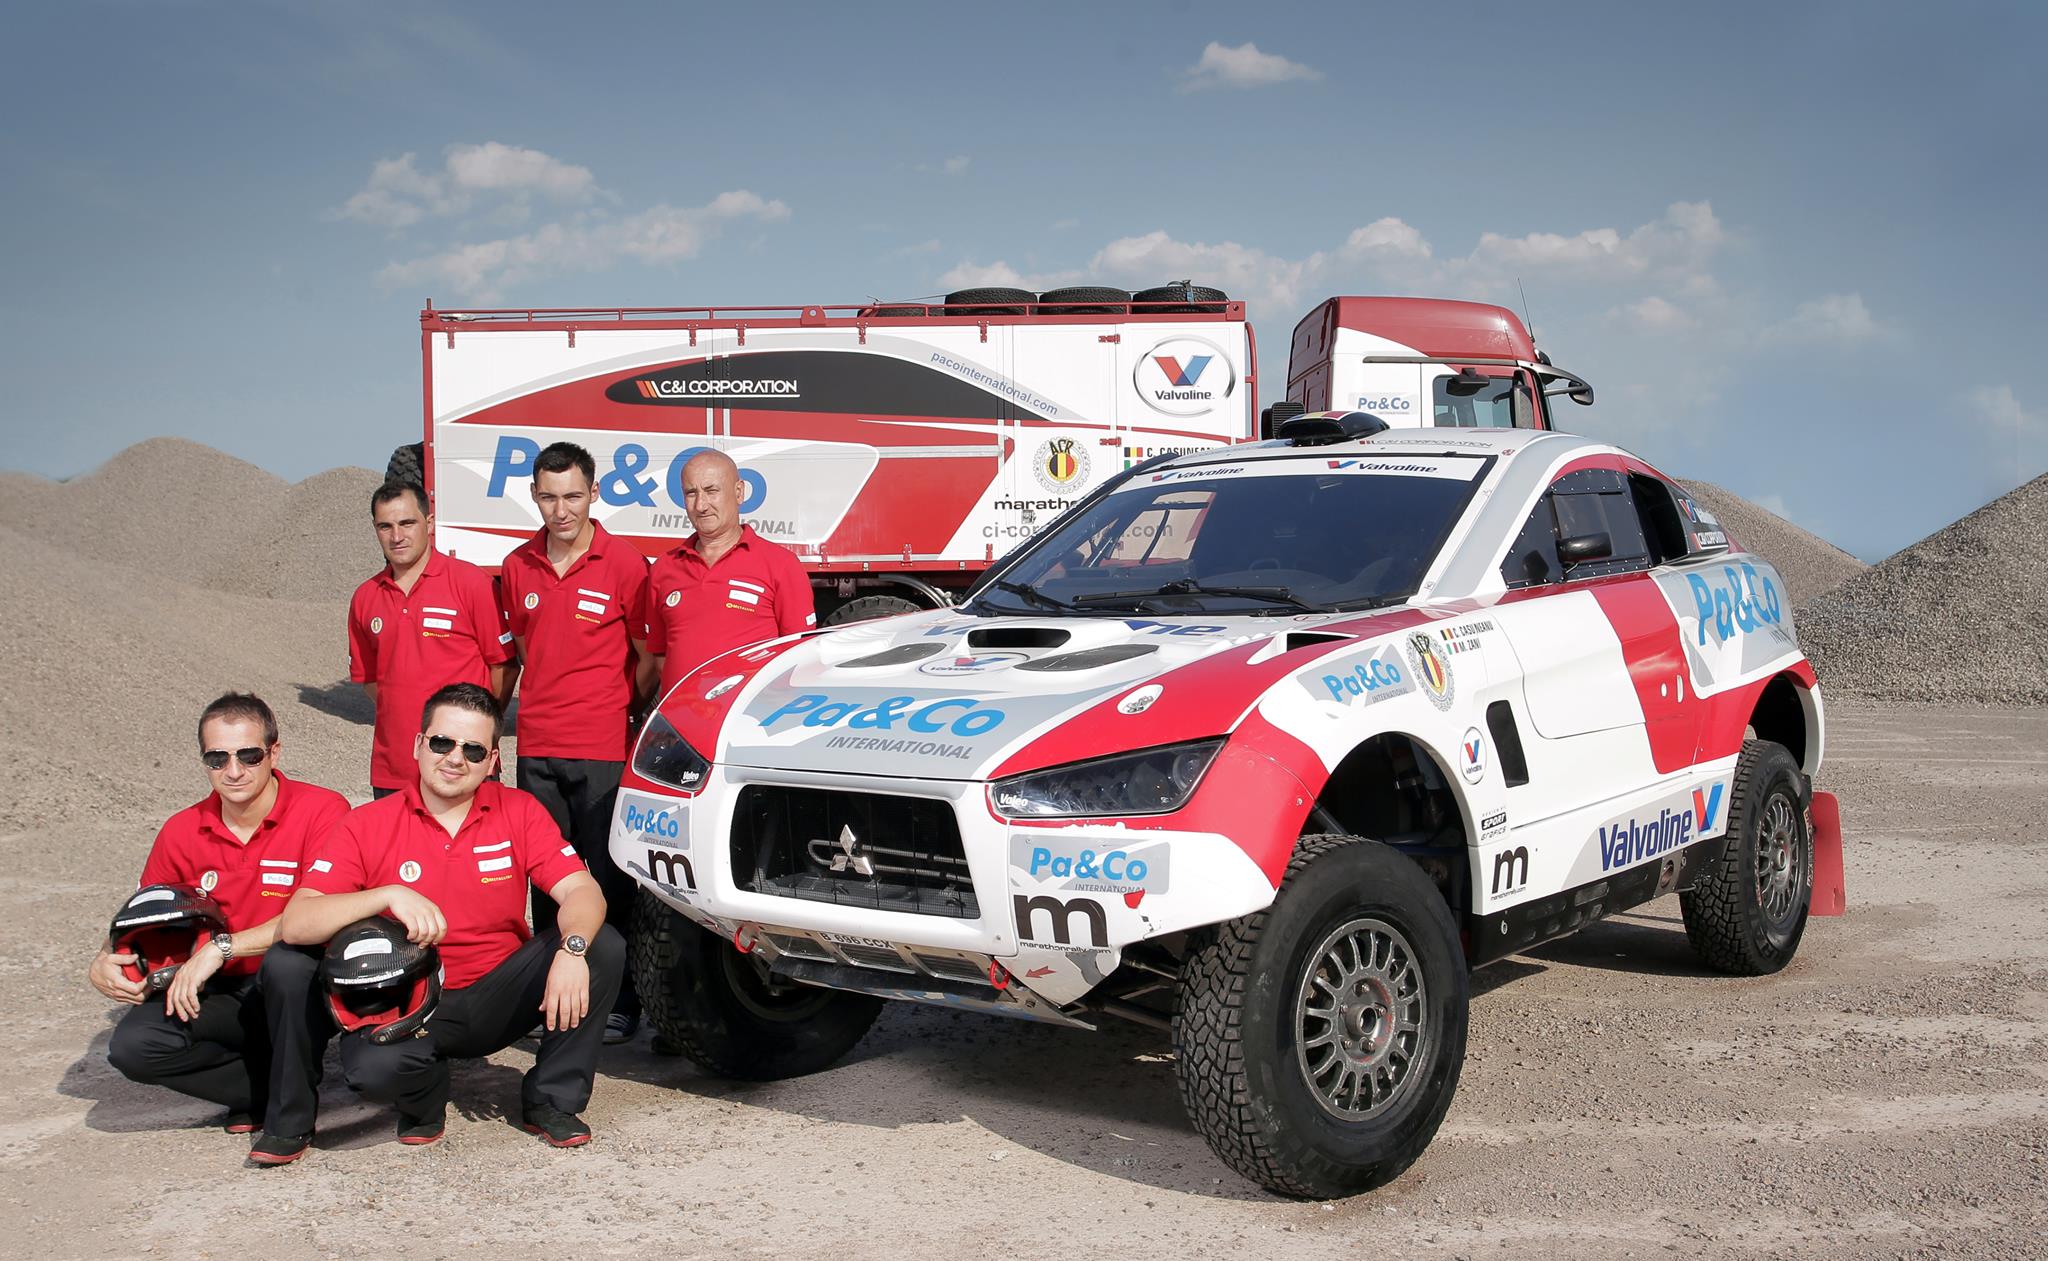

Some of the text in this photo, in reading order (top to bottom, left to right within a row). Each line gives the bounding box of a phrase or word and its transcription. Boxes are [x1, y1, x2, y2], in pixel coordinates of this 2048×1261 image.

[660, 379, 798, 394] C&I CORPORATION
[930, 350, 1059, 415] pacointernational.com
[1155, 390, 1212, 400] Valvoline
[1357, 397, 1410, 411] Pa&Co
[1177, 467, 1245, 479] Valvoline
[1359, 462, 1438, 473] Valvoline
[1686, 562, 1780, 647] Pa&Co
[1322, 659, 1401, 703] Pa&Co
[758, 694, 1006, 737] Pa&Co
[826, 735, 973, 760] INTERNATIONAL
[1000, 793, 1028, 808] Valeo
[626, 804, 679, 838] Pa&Co
[1599, 807, 1693, 872] Valvoline
[1029, 847, 1148, 882] Pa&Co
